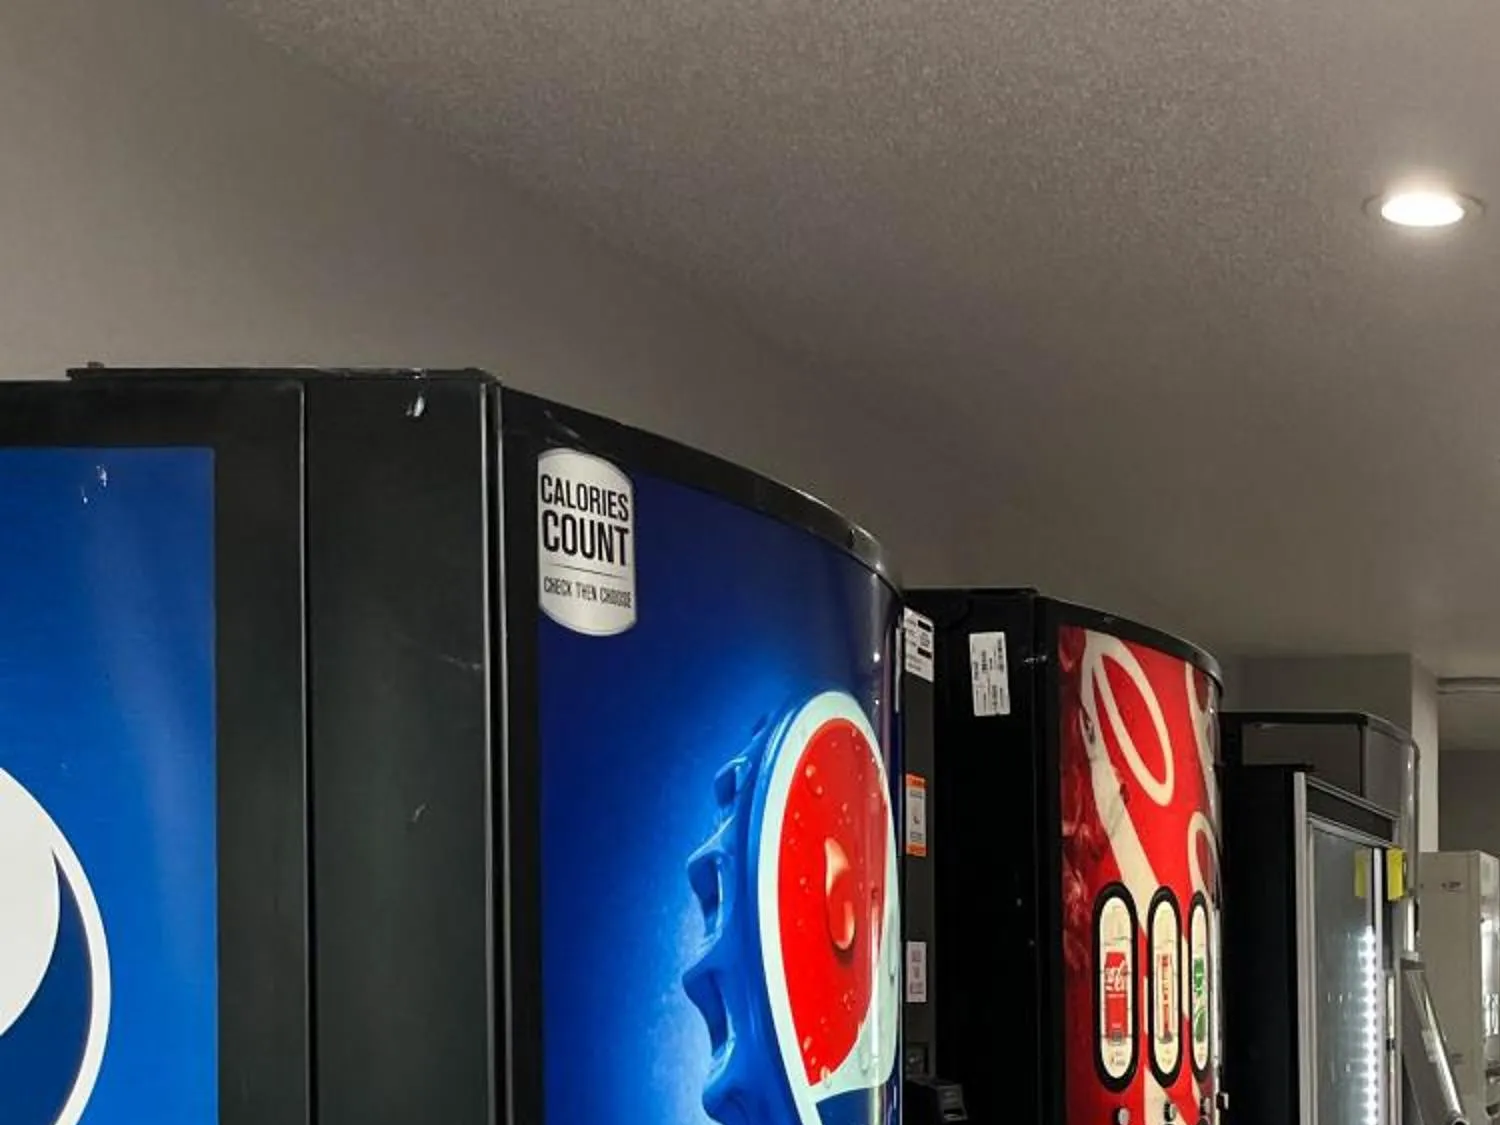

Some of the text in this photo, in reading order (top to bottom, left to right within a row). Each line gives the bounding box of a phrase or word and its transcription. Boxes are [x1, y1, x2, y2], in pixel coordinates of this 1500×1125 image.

[540, 473, 630, 522] CALORIES
[541, 509, 630, 567] COUNT
[543, 576, 632, 609] CHECK THEN CHOOSE
